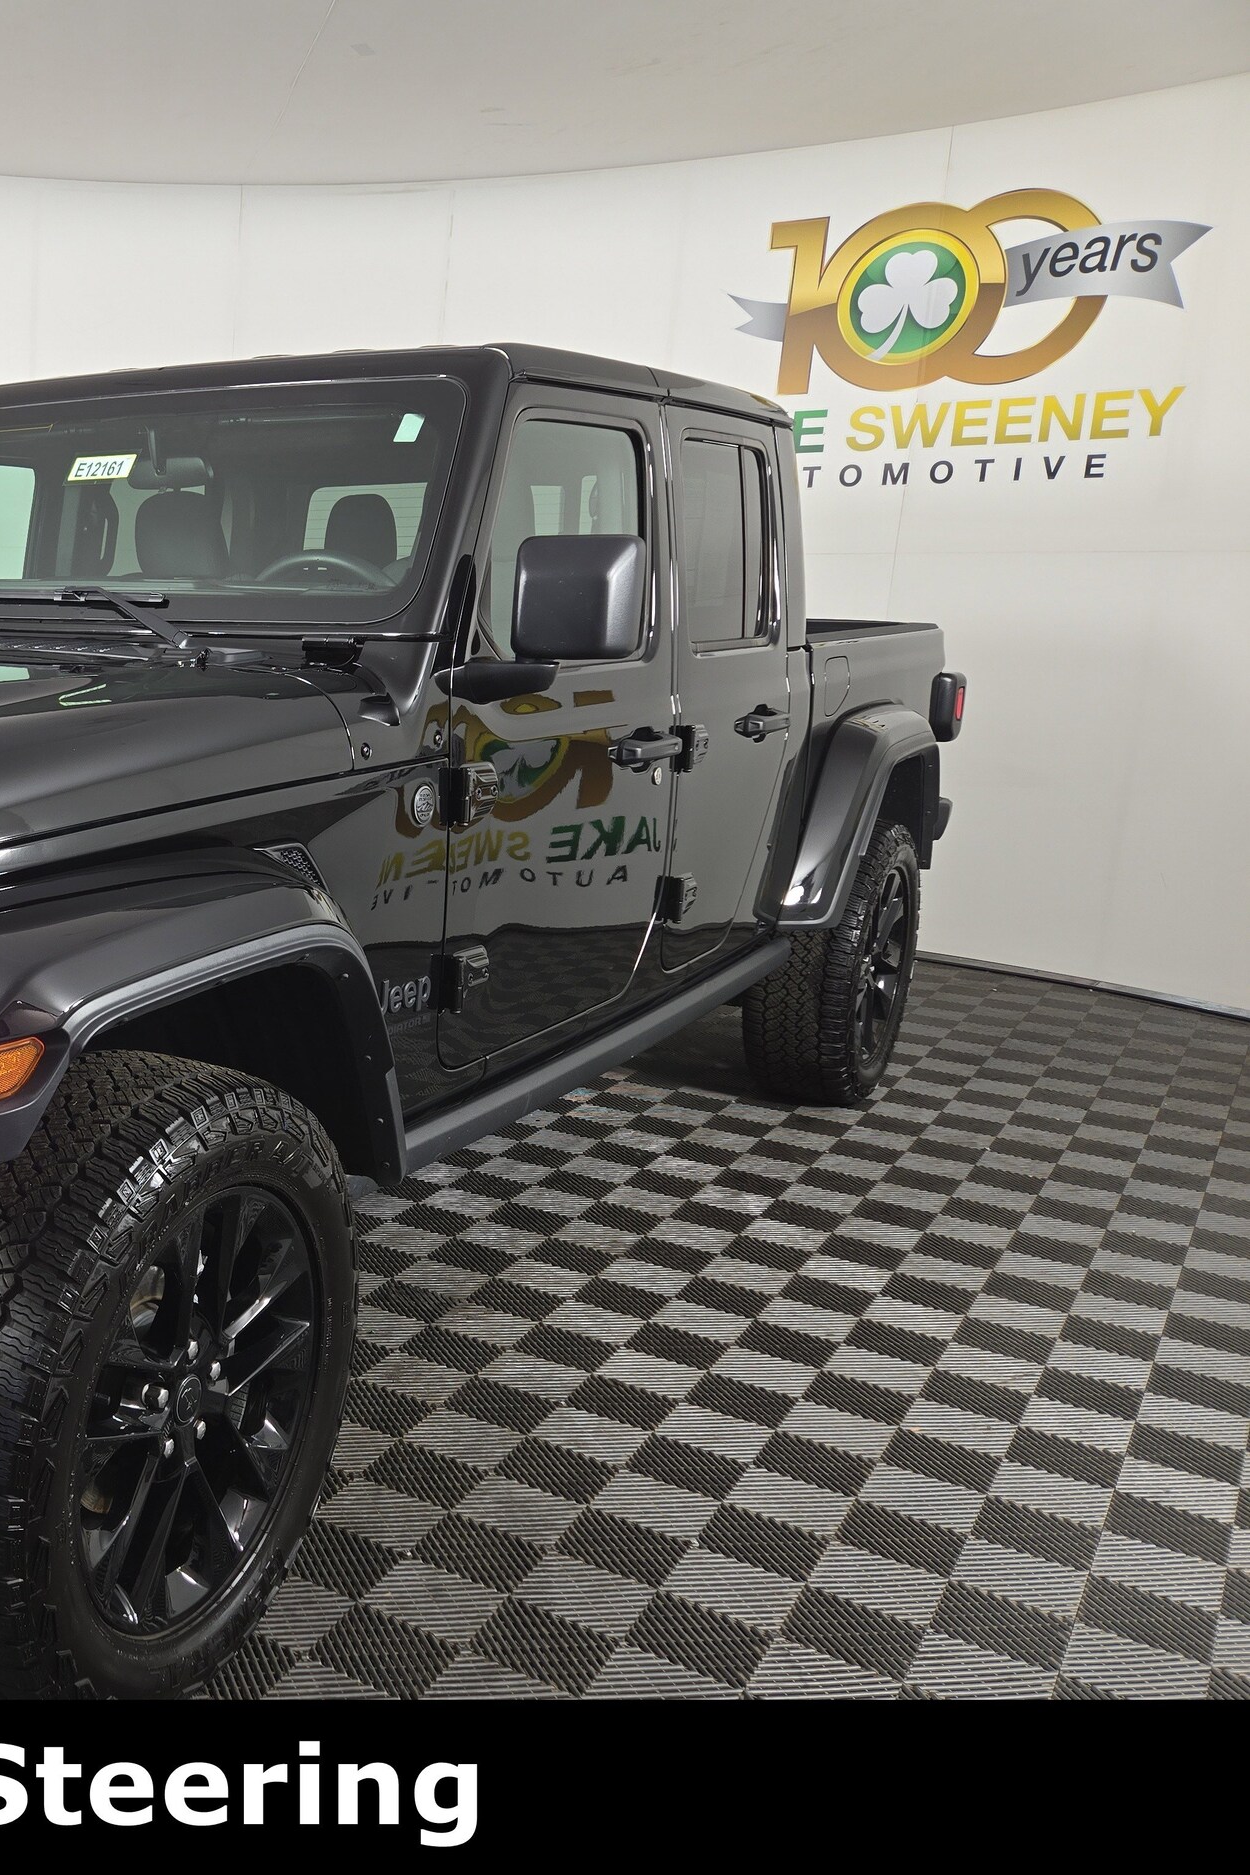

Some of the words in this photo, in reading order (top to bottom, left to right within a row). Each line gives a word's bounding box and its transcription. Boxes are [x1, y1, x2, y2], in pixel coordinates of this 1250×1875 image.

[1015, 231, 1163, 298] years
[770, 187, 1108, 396] 100
[845, 385, 1187, 453] SWEENEY
[74, 460, 124, 479] E12161
[802, 454, 1108, 489] TOMOTIVE
[381, 976, 431, 1016] Jeep
